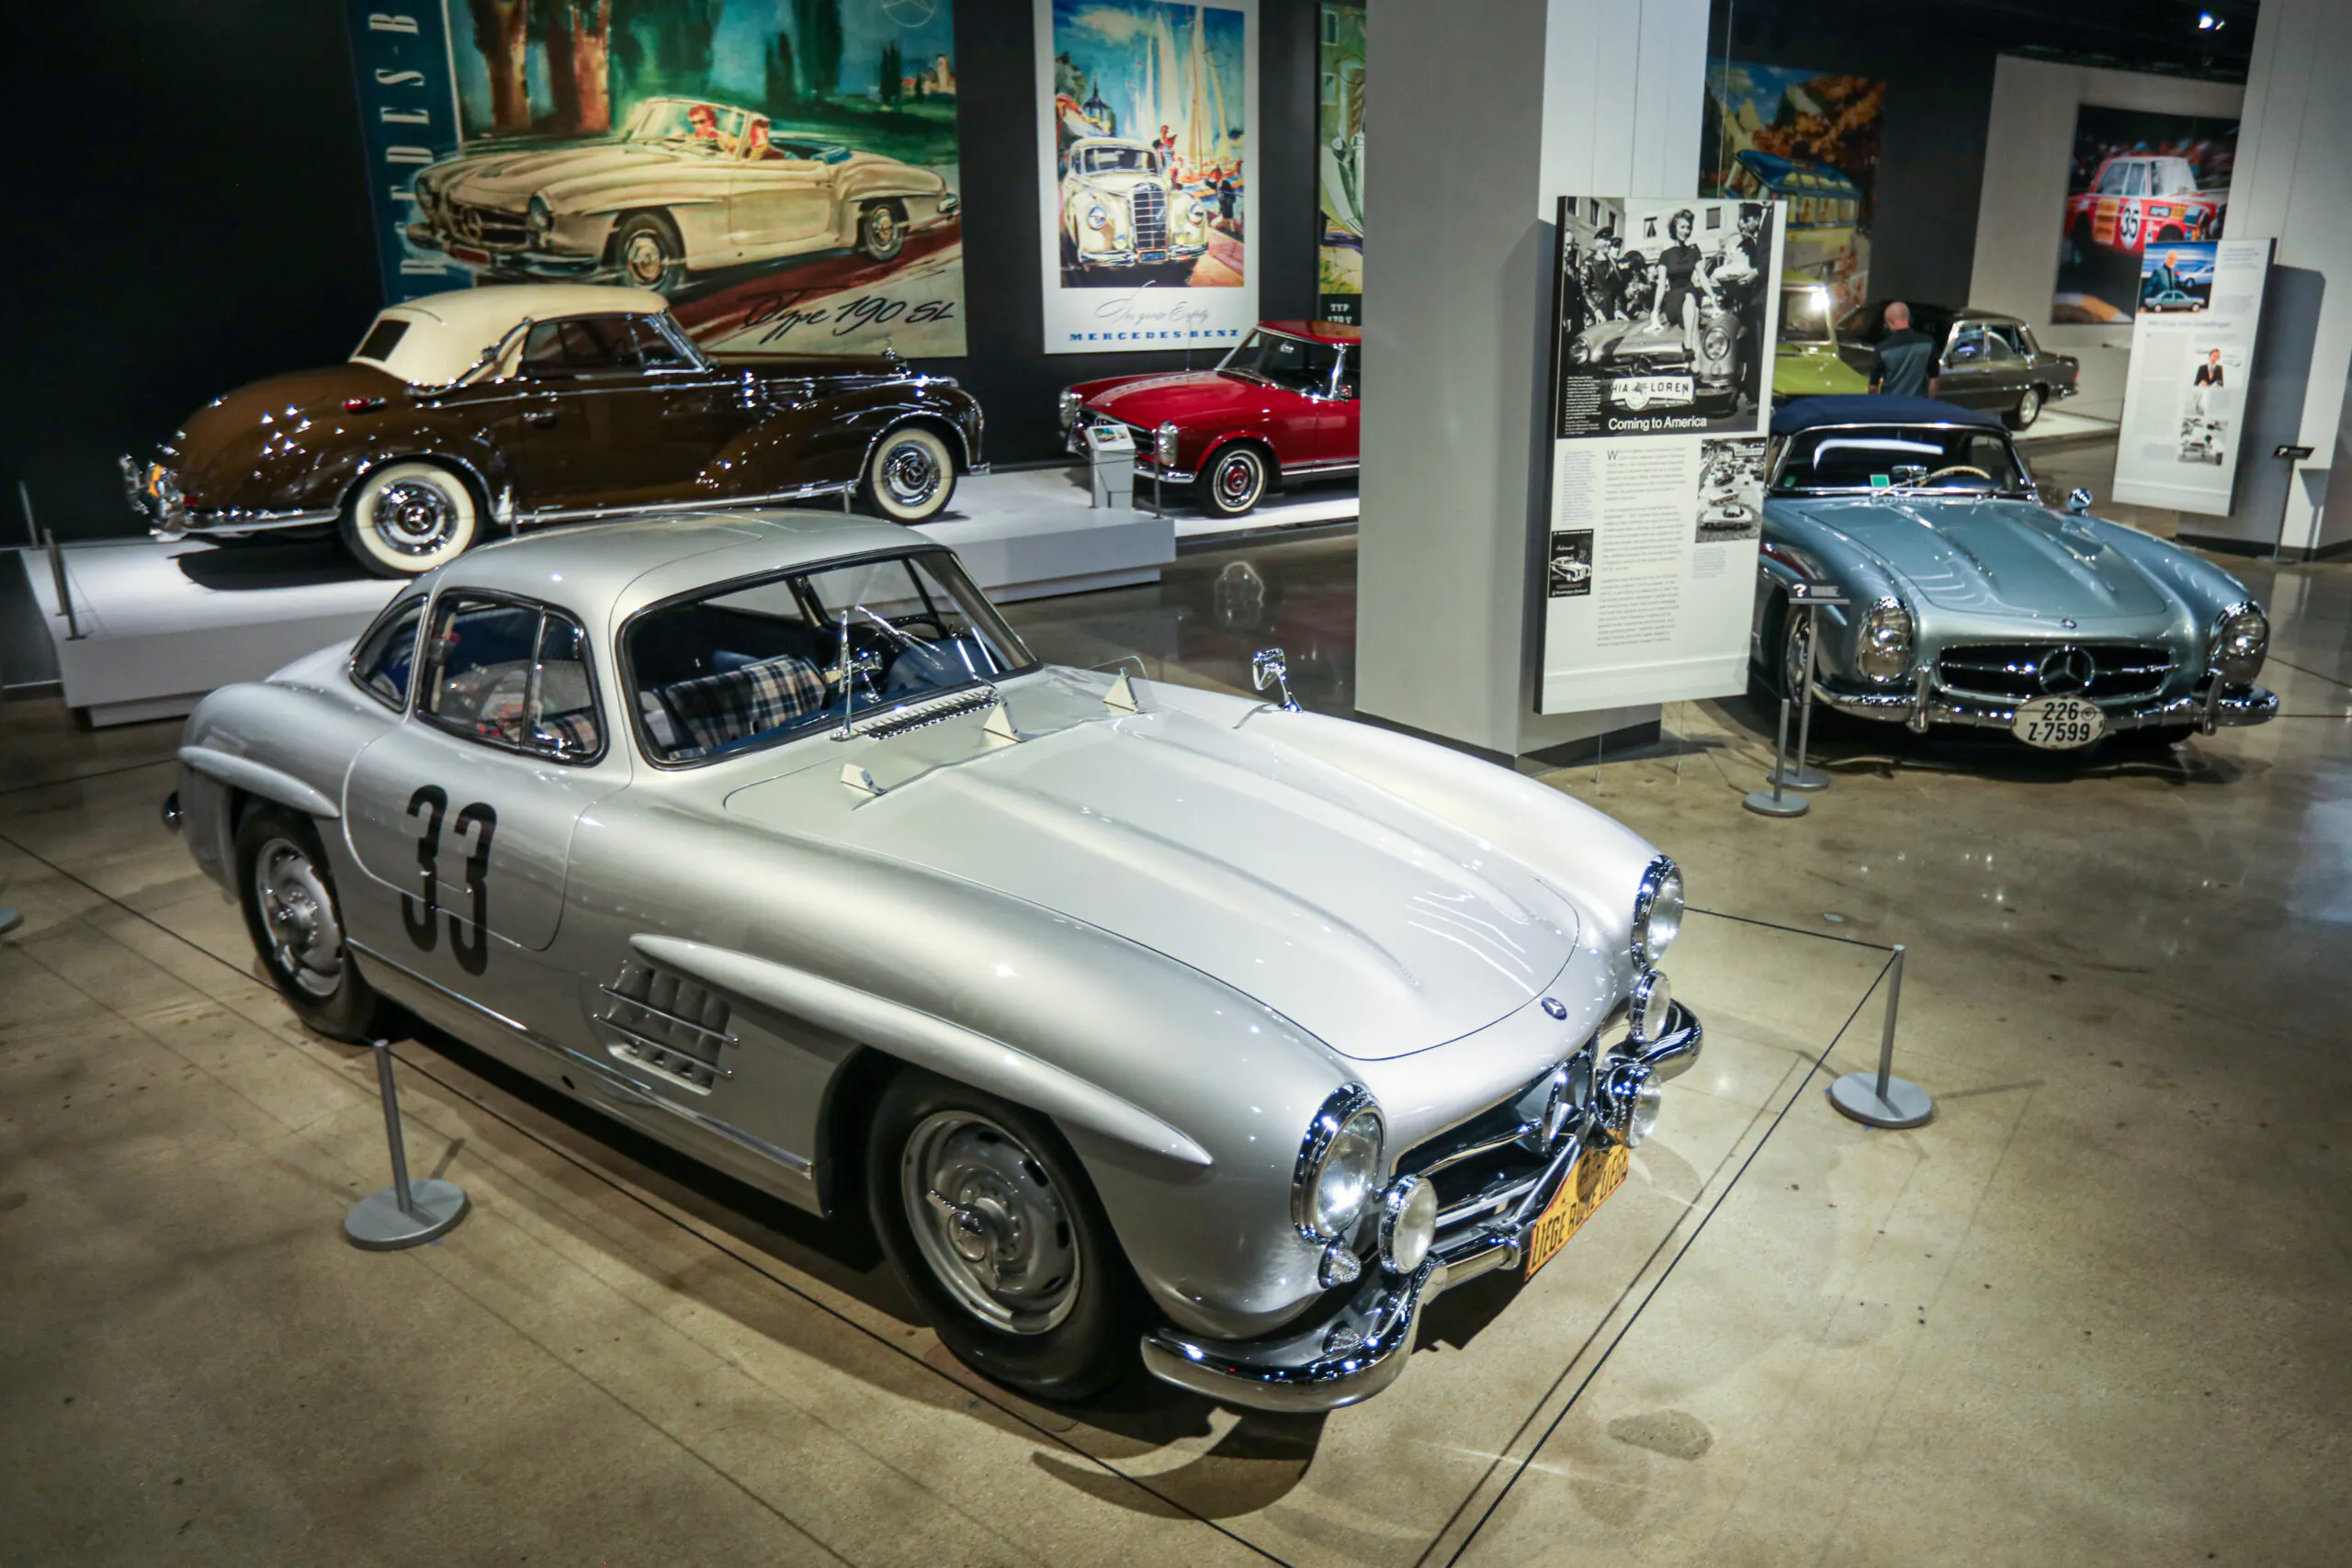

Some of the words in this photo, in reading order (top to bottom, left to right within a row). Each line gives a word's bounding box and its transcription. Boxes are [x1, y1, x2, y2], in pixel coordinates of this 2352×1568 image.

[2120, 208, 2140, 239] 35
[832, 294, 908, 337] 190
[906, 299, 956, 324] SL
[1069, 329, 1240, 342] MERCEDES-BENZ
[1650, 382, 1690, 394] LOREN
[1608, 417, 1650, 432] Coming
[1652, 417, 1663, 429] to
[1664, 415, 1707, 429] America
[2042, 702, 2079, 721] 226
[2028, 722, 2091, 742] Z-7599
[401, 784, 497, 977] 33
